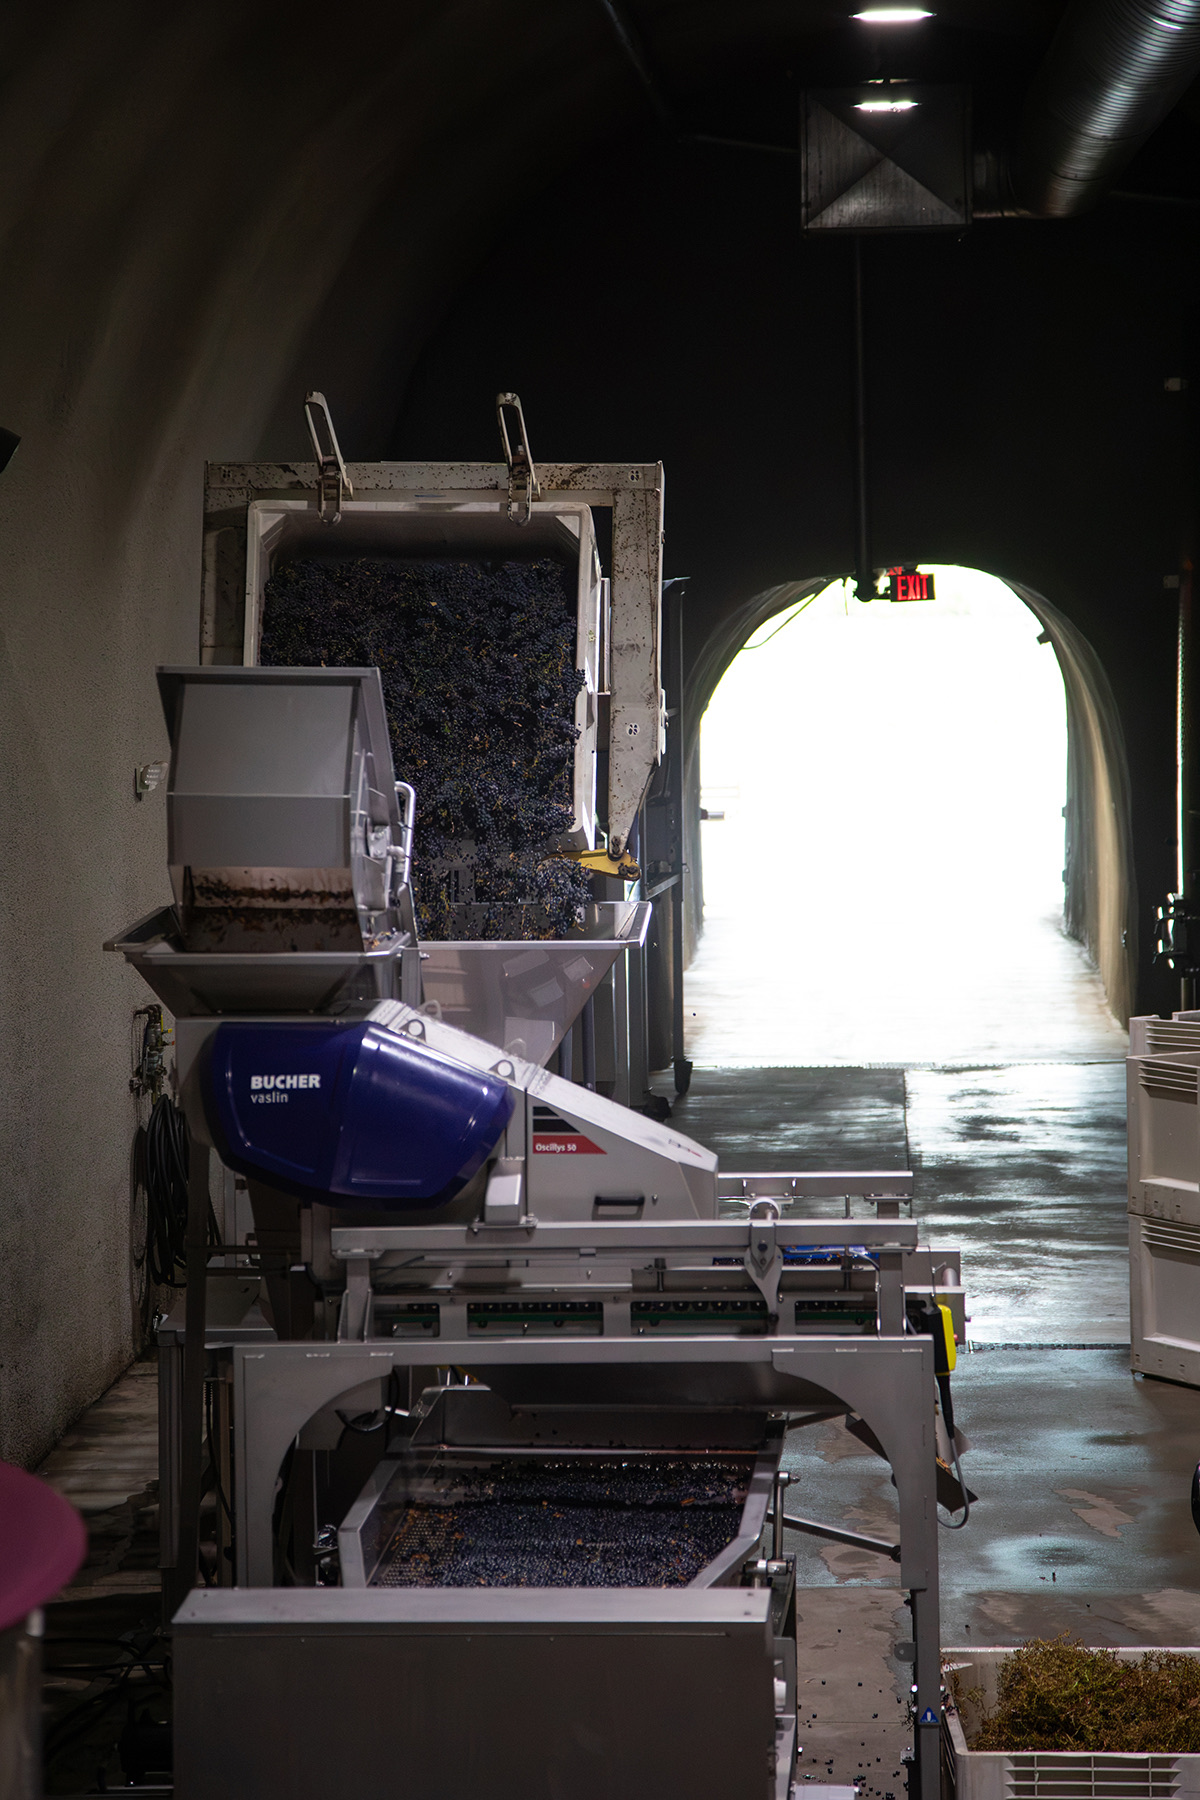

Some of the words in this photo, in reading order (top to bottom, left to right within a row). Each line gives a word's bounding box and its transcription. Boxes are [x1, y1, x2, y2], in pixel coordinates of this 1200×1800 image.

[897, 575, 928, 601] EXIT
[251, 1074, 321, 1090] BUCHER
[250, 1091, 288, 1104] vaslin
[535, 1143, 565, 1153] Oscillys
[566, 1143, 577, 1152] 50
